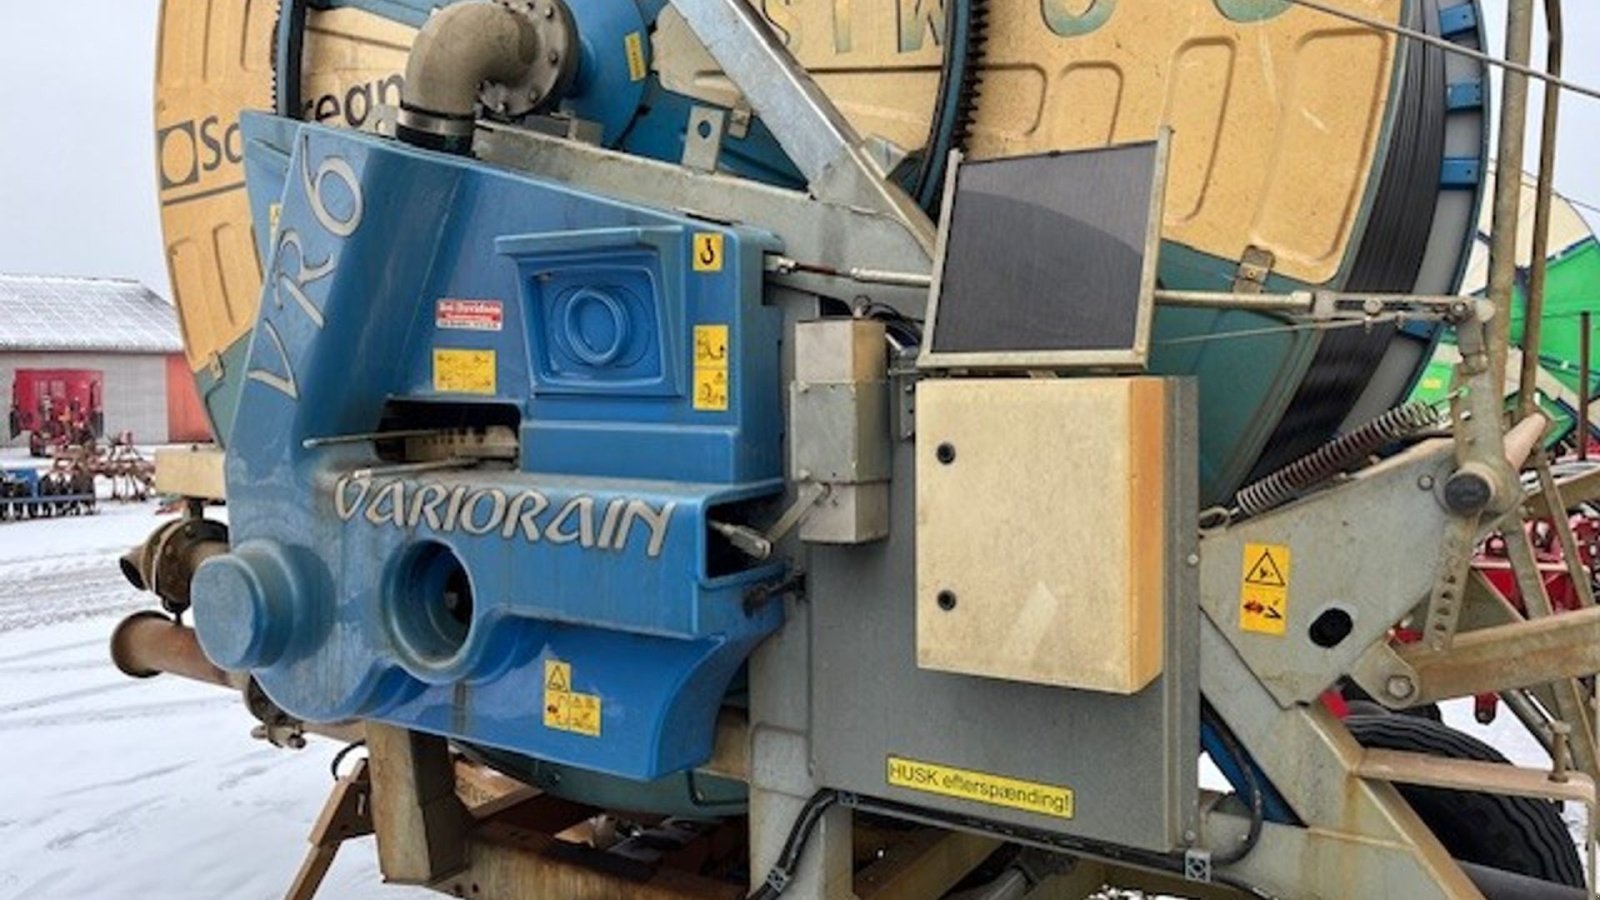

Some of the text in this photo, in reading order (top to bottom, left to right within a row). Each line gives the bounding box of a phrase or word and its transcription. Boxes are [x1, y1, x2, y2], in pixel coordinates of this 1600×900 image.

[247, 134, 364, 401] VR6
[334, 474, 676, 557] VARIORAIN
[889, 764, 1069, 813] HUSK efterspænding!
